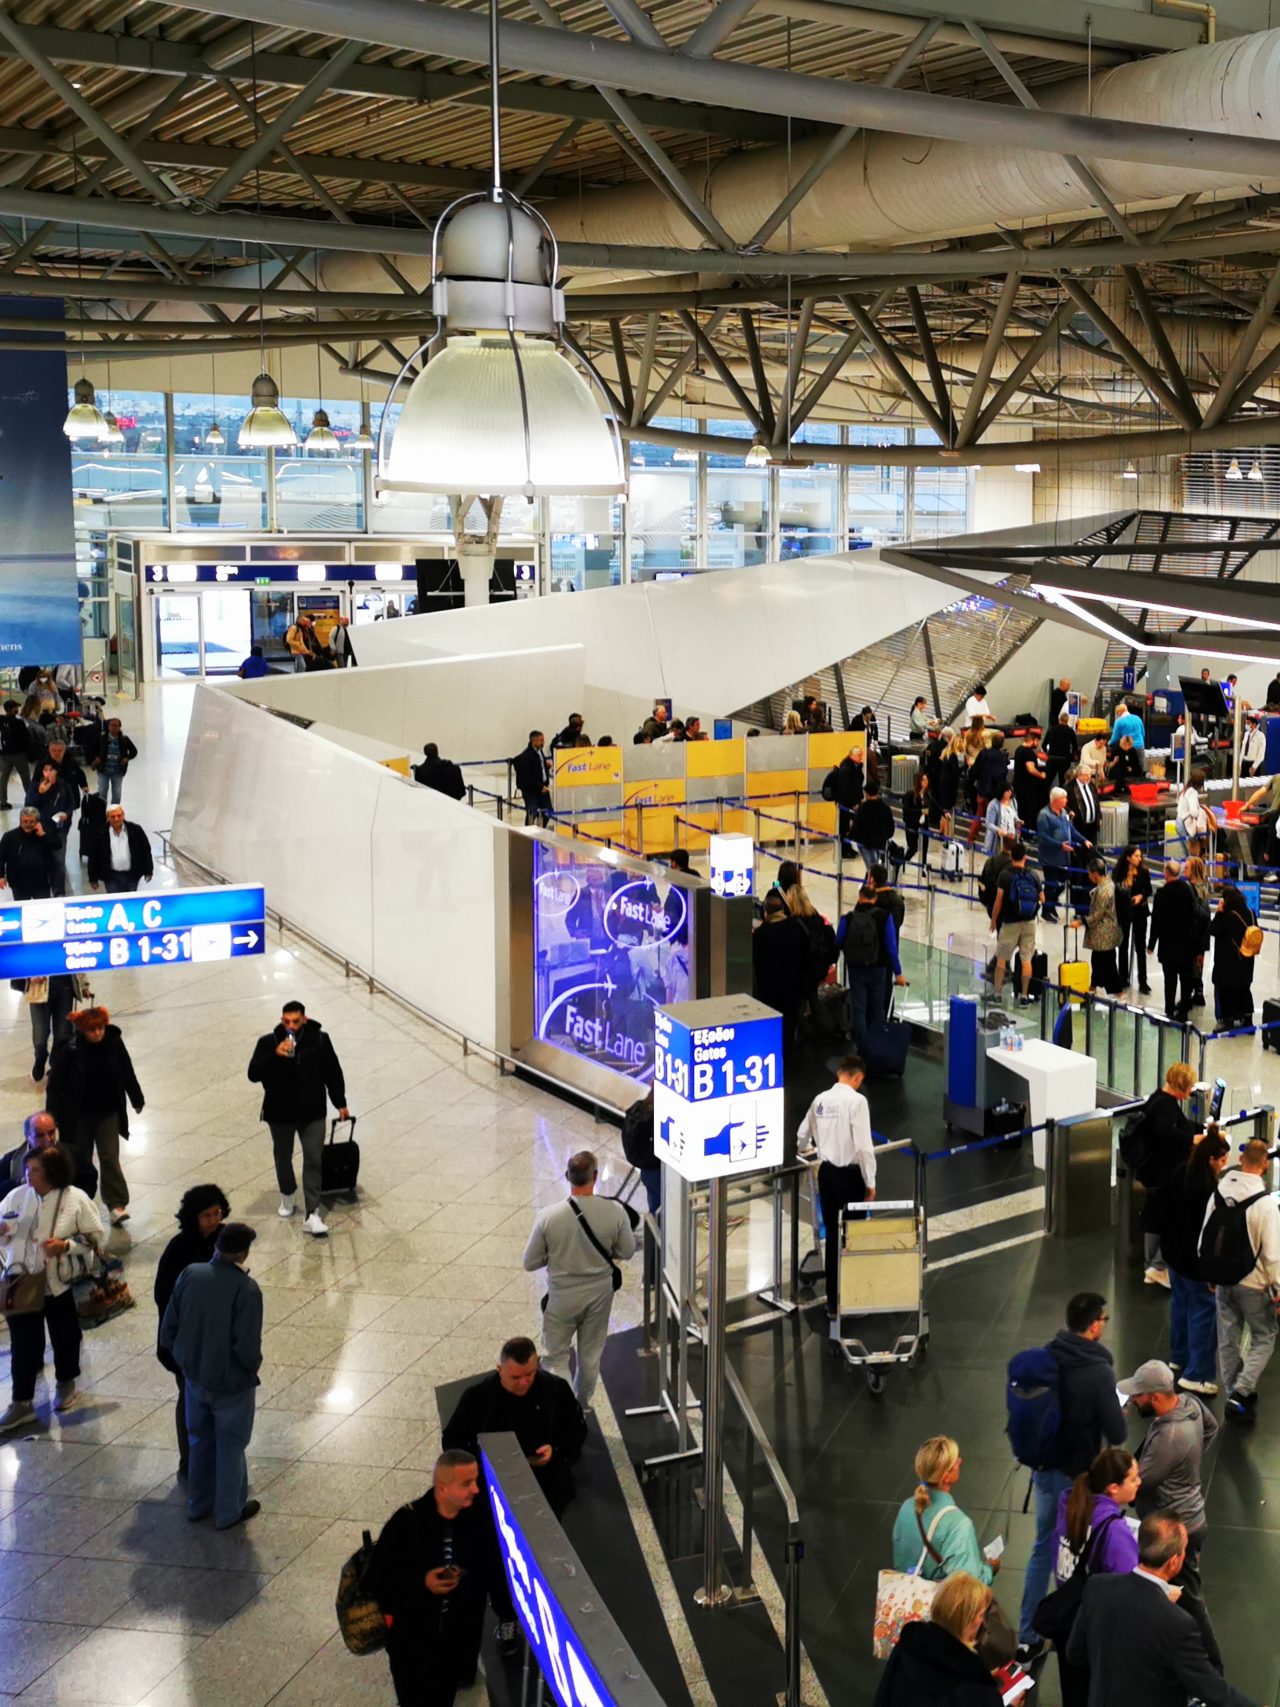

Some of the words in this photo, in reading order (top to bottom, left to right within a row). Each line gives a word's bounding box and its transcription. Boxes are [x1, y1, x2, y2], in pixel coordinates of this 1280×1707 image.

[152, 565, 163, 582] 3
[521, 565, 530, 580] 3
[1125, 672, 1134, 685] 17
[567, 762, 588, 773] Fast
[588, 762, 611, 771] Lane
[142, 900, 162, 928] C
[620, 896, 645, 921] Fast
[645, 905, 671, 931] Lane
[109, 937, 130, 966] B
[138, 932, 191, 962] 1-31
[565, 1004, 603, 1049] Fast
[604, 1021, 645, 1064] Lane
[693, 1046, 727, 1063] Gates
[655, 1045, 665, 1080] B
[665, 1053, 689, 1098] 1-31
[693, 1063, 714, 1100] B
[721, 1053, 776, 1095] 1-31
